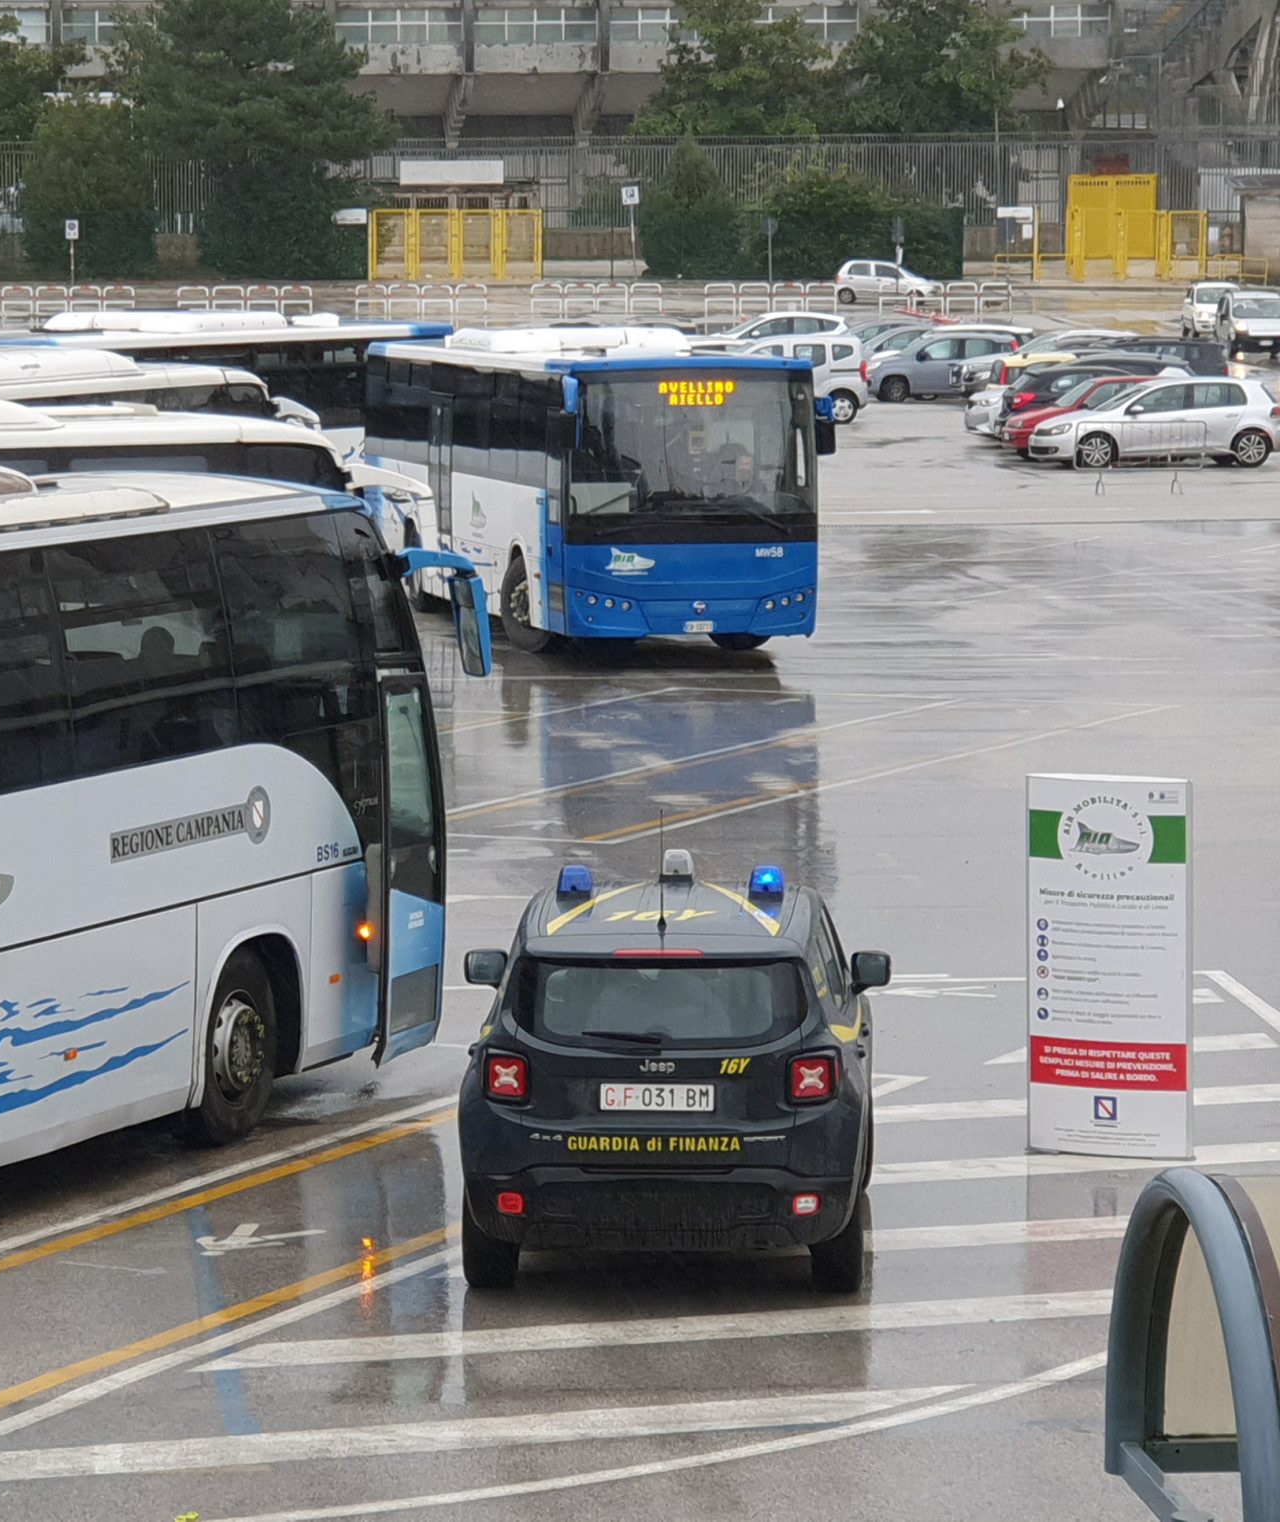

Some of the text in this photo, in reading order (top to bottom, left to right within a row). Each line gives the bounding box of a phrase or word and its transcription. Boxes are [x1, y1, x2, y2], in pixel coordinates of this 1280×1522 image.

[658, 381, 735, 394] AVELLINO
[668, 394, 724, 406] AIELLO
[111, 808, 245, 859] REGIONE CAMPANIA
[1063, 816, 1075, 835] AIR
[317, 843, 340, 862] BS16
[1039, 888, 1175, 901] Misure di sicurezza precauzionali
[1053, 1046, 1078, 1056] PREGA
[1079, 1048, 1087, 1056] DI
[1088, 1049, 1137, 1060] RISPETTARE
[1138, 1051, 1171, 1061] QUESTE
[639, 1058, 676, 1074] Jeep
[719, 1057, 751, 1075] 16Y
[1039, 1055, 1074, 1066] SEMPLICI
[1075, 1060, 1105, 1069] MISURE
[1106, 1062, 1115, 1070] DI
[1055, 1068, 1081, 1078] PRIMA
[1081, 1070, 1090, 1079] DI
[1091, 1071, 1118, 1081] SALIRE
[641, 1087, 676, 1108] 031
[685, 1087, 710, 1109] BM
[566, 1135, 741, 1152] GUARDIA di FINANZA
